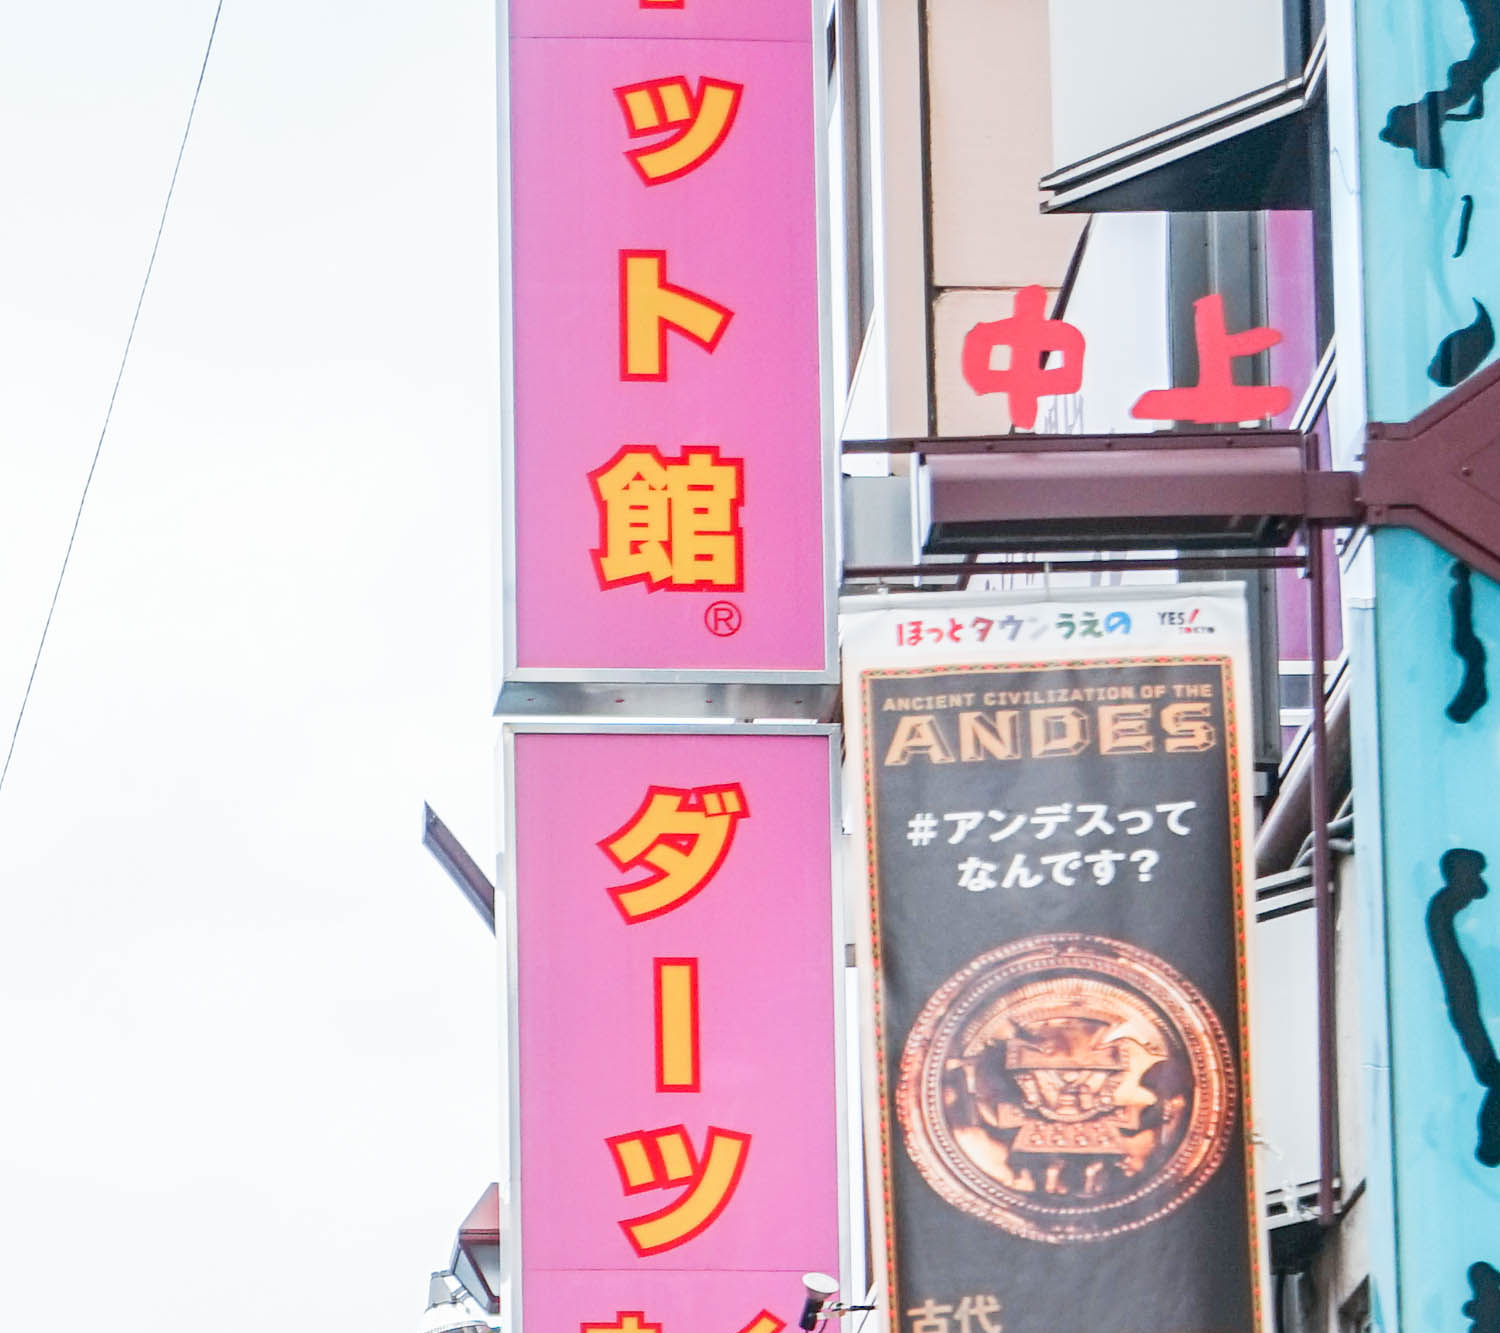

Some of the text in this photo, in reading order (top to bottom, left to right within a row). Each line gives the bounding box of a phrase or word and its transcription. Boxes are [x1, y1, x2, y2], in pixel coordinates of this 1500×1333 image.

[896, 608, 1199, 647] ほっとタウンうえの YES!
[883, 683, 1212, 712] ANCIENT CIVILIZATION OF THE
[883, 702, 1217, 766] ANDES
[906, 800, 1197, 847] #アンデスって
[957, 848, 1159, 892] なんです?
[599, 782, 752, 1256] ダーツ
